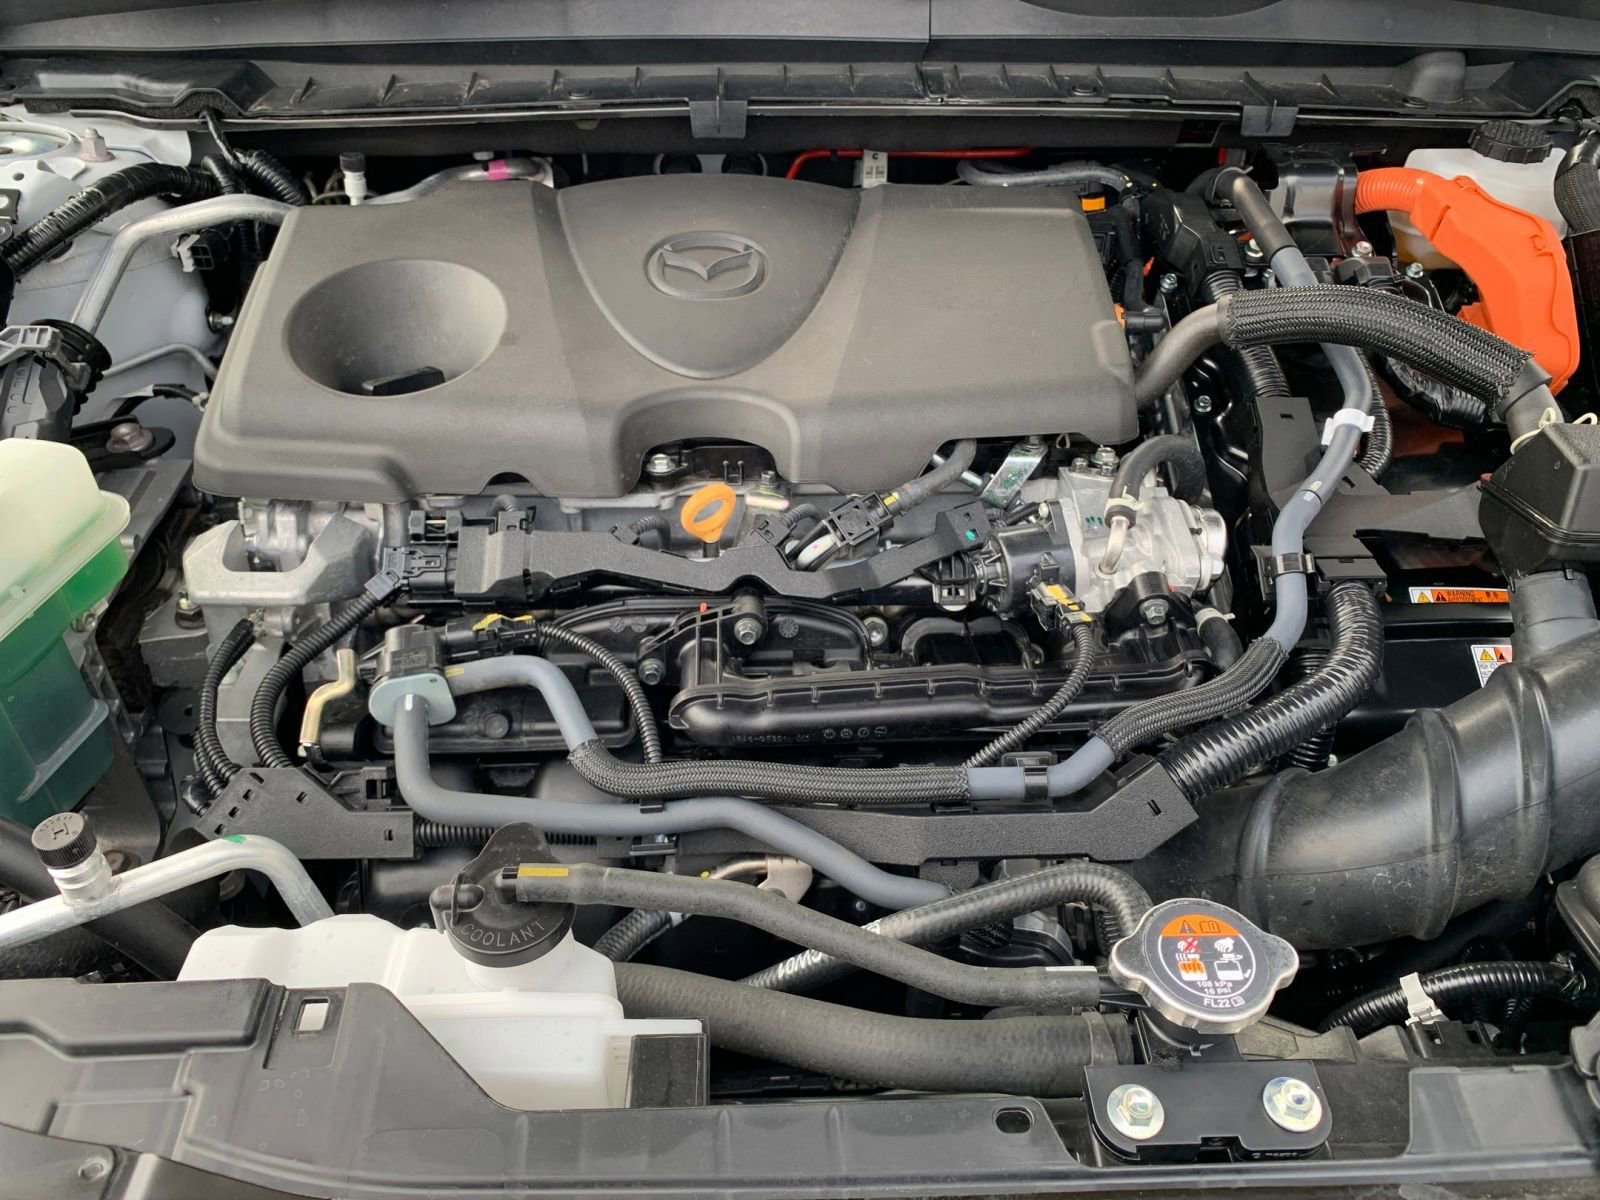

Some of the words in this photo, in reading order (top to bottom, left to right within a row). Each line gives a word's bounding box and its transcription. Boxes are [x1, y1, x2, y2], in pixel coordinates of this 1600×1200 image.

[461, 919, 545, 947] COOLANT
[1196, 980, 1213, 988] 108
[1214, 980, 1233, 988] kPa
[1203, 997, 1232, 1008] FL22
